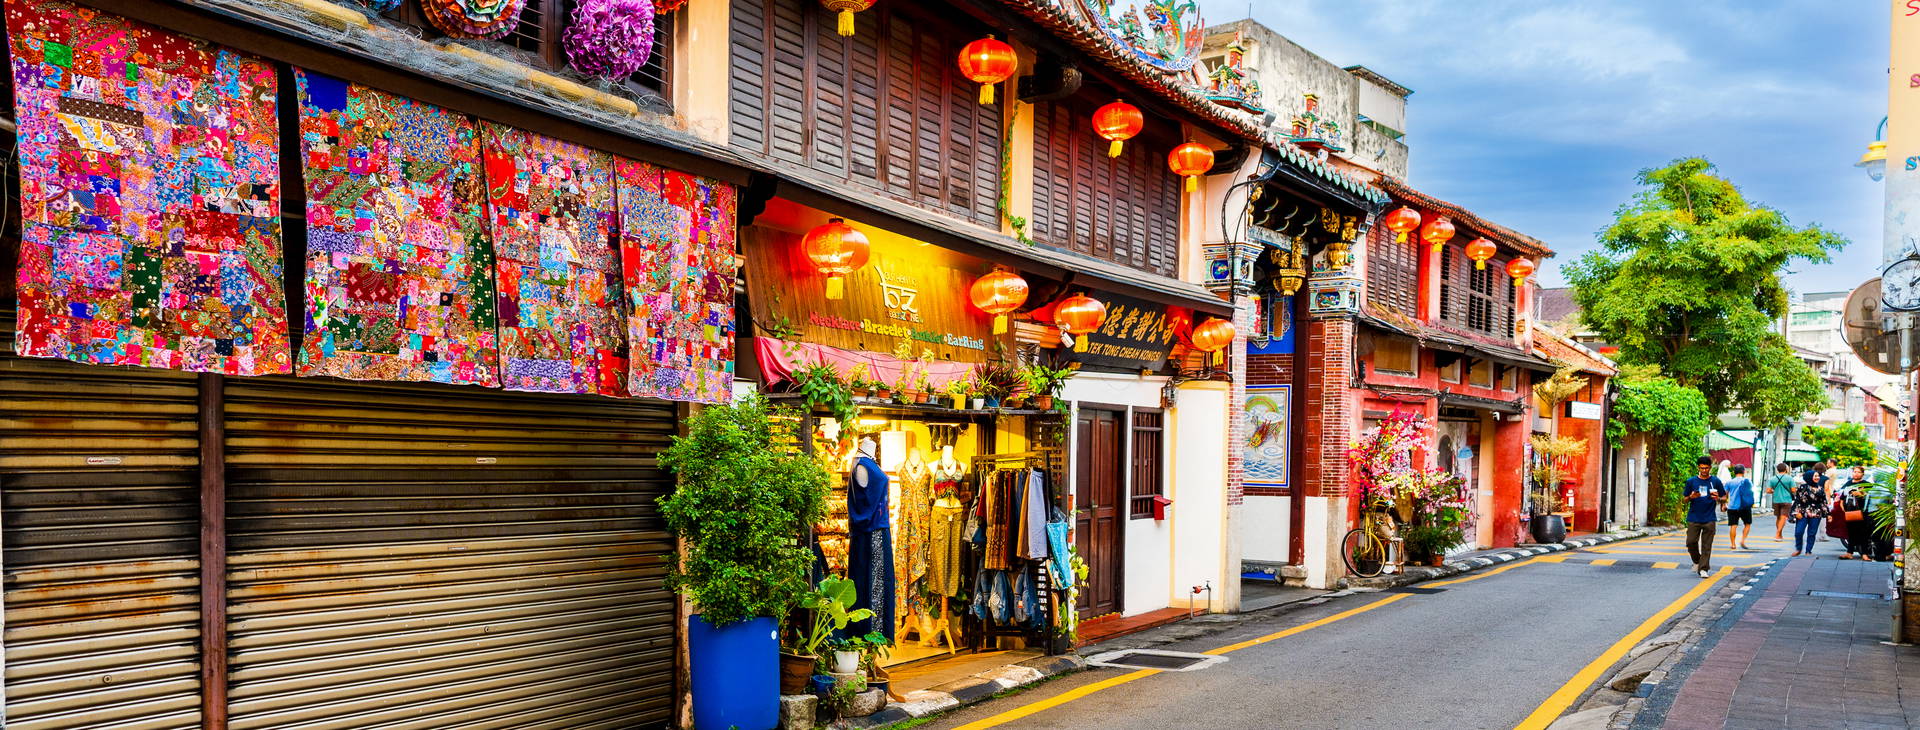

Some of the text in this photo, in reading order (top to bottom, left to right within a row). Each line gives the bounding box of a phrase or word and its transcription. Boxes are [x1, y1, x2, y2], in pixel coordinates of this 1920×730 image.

[809, 311, 860, 331] Necklace
[863, 318, 908, 338] Bracelet
[946, 333, 984, 351] EarRing
[1087, 342, 1103, 355] TEK
[1102, 343, 1121, 357] TONG
[1119, 346, 1141, 359] CHEAH
